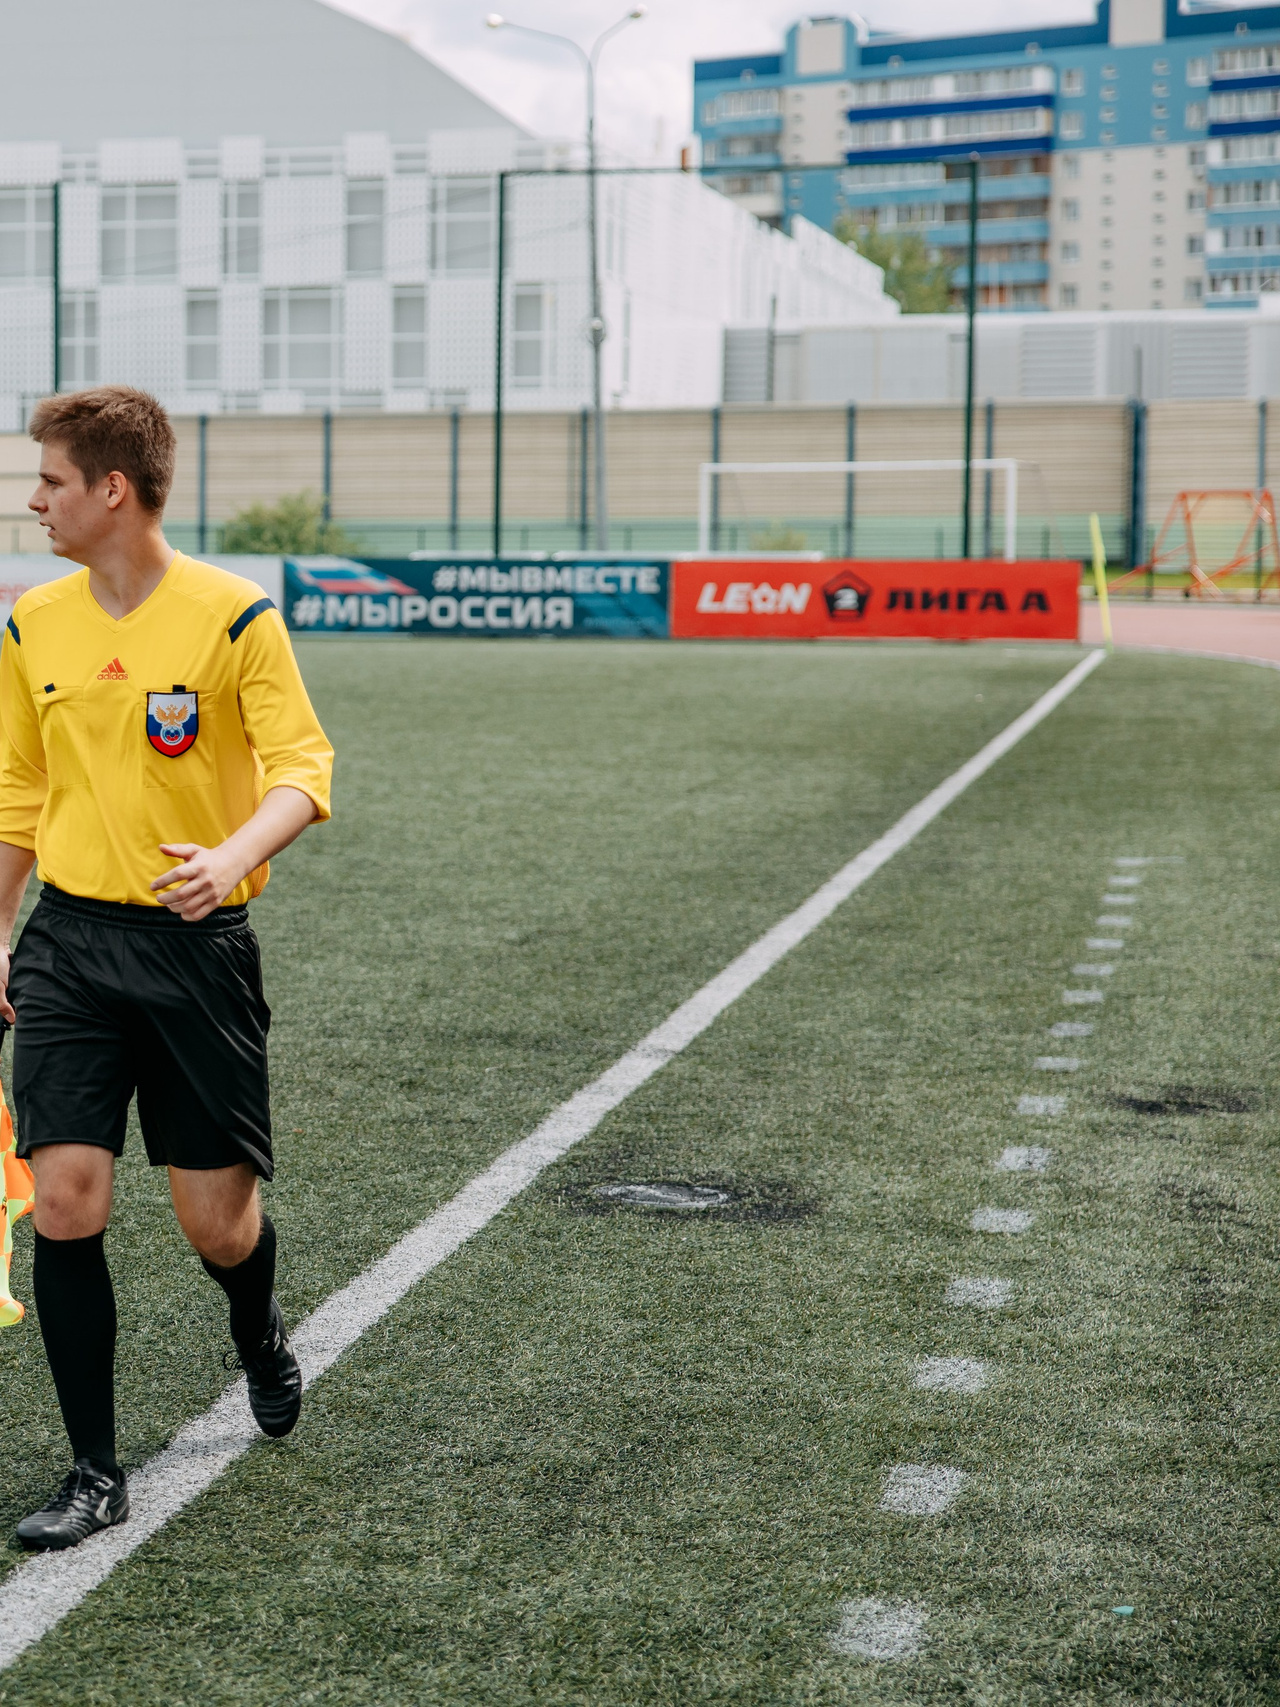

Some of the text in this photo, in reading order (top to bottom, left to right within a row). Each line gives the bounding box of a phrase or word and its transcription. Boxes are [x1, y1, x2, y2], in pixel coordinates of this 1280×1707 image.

[433, 566, 661, 593] #МЫВМЕСТЕ
[291, 596, 574, 628] #МЫРОССИЯ
[884, 587, 1007, 613] ЛИГА
[97, 671, 128, 680] adidas
